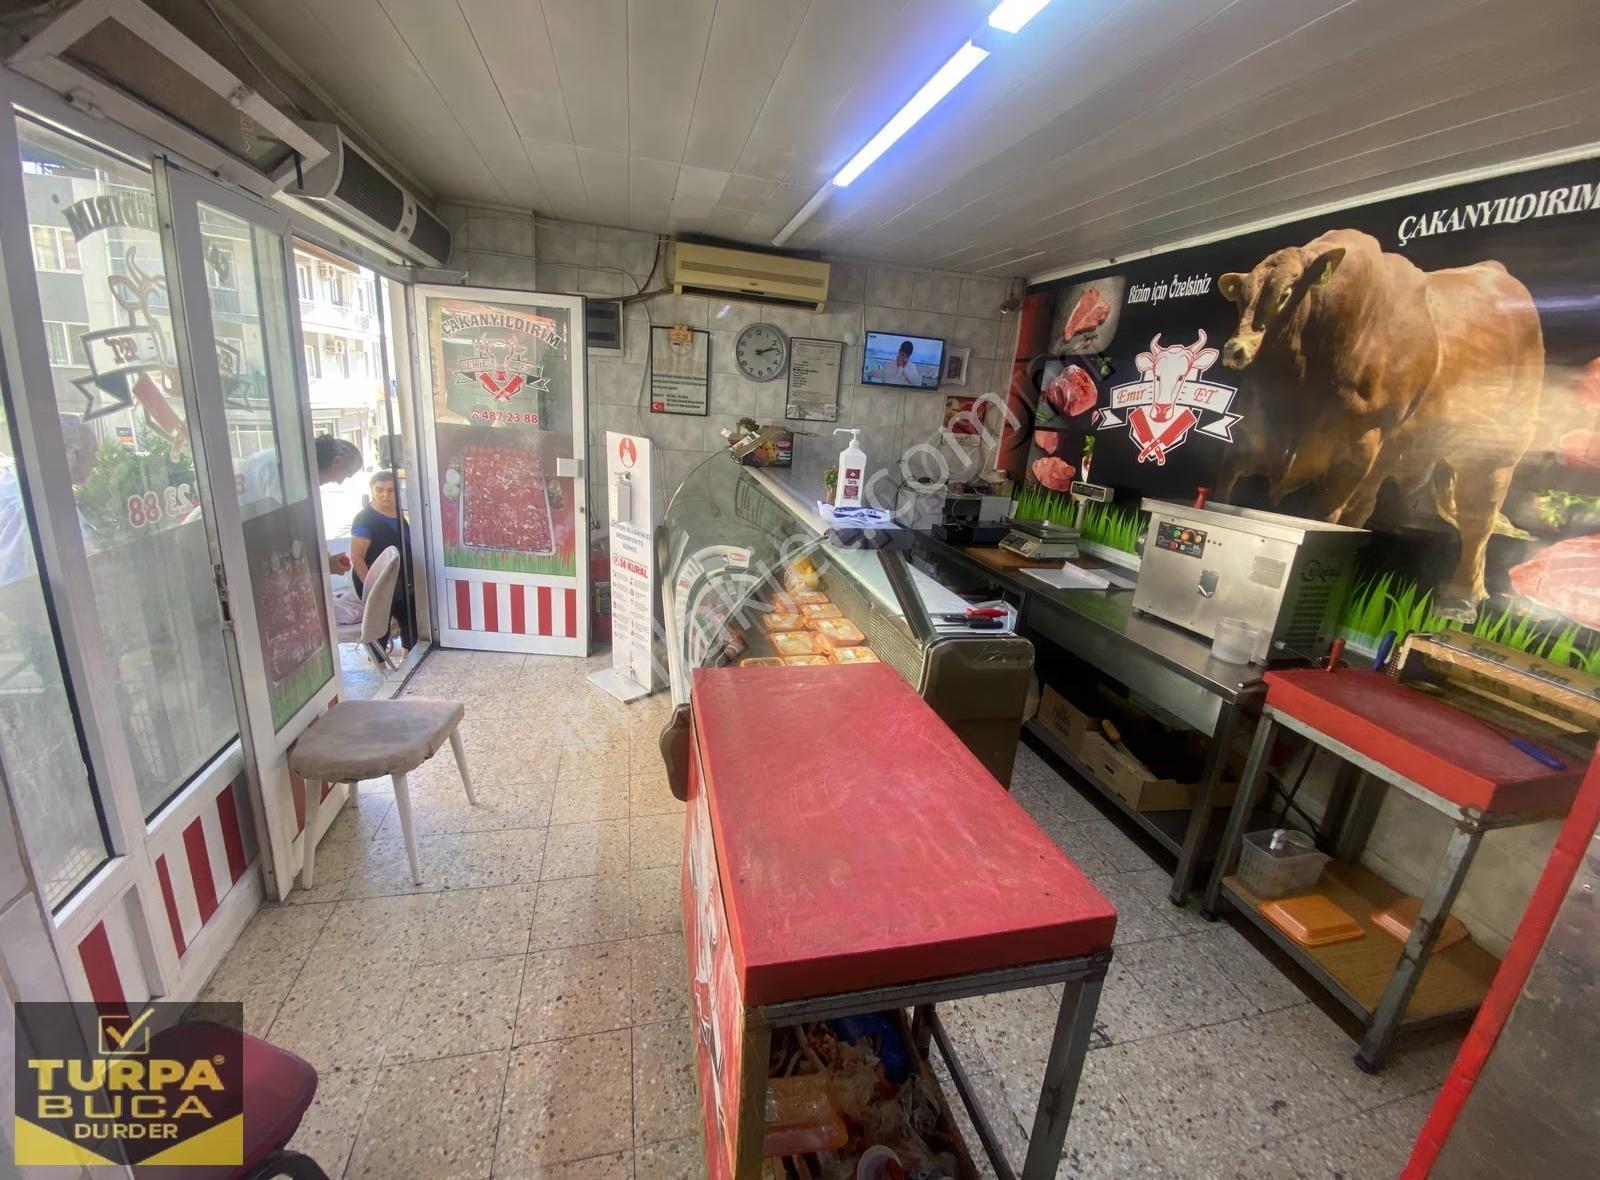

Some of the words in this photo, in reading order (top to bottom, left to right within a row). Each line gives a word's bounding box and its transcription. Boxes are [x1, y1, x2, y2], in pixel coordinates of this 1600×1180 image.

[1397, 182, 1600, 247] ÇAKANYILDIRIM
[1127, 284, 1151, 304] Bizim
[1151, 281, 1168, 306] için
[1169, 272, 1213, 298] Özelsiniz
[1116, 385, 1147, 404] Emir
[1193, 387, 1219, 404] ET
[481, 411, 502, 422] 487
[507, 412, 521, 422] 23
[524, 412, 539, 424] 88
